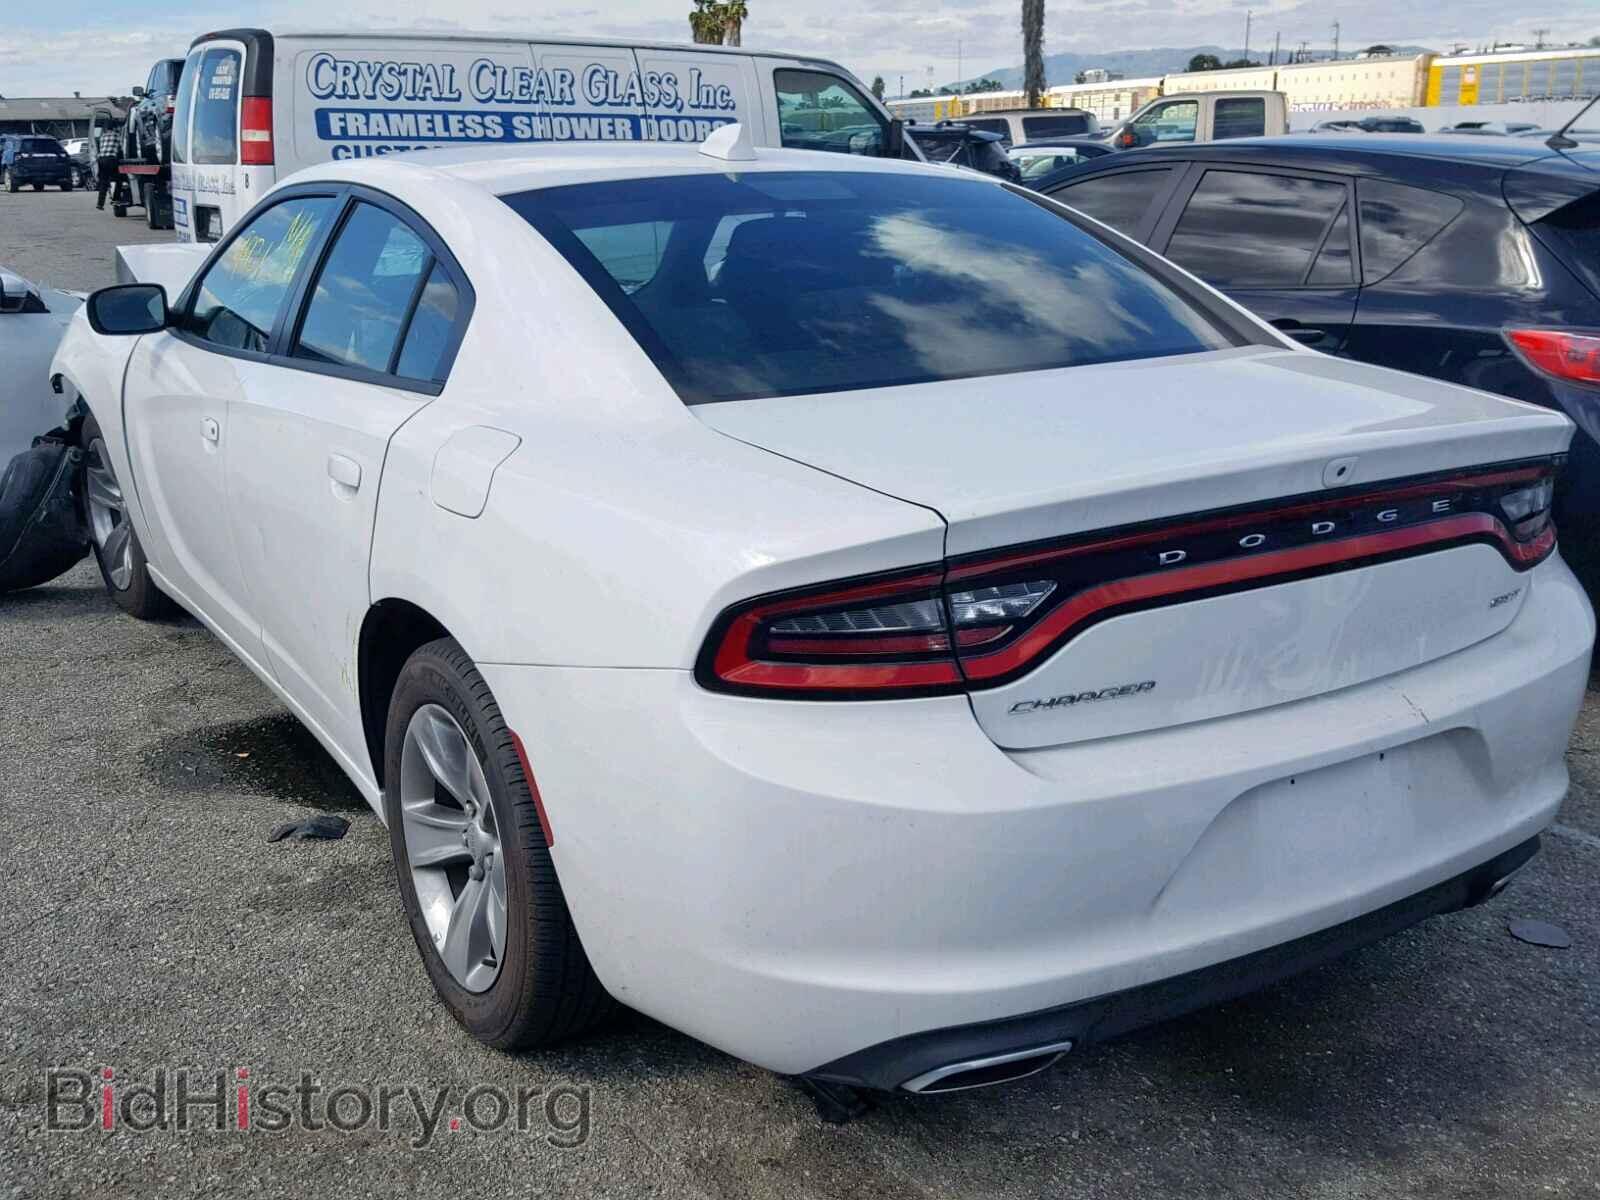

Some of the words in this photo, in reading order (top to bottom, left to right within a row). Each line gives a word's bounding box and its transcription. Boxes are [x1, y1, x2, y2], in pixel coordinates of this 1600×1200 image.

[306, 52, 462, 102] CRYSTAL
[468, 58, 576, 106] CLEAR
[582, 63, 685, 113] GLASS,
[688, 67, 736, 111] Inc.
[328, 111, 505, 139] FRAMELESS
[511, 114, 634, 141] SHOWER
[1158, 499, 1452, 567] DODGE
[1007, 680, 1157, 715] CHARGER
